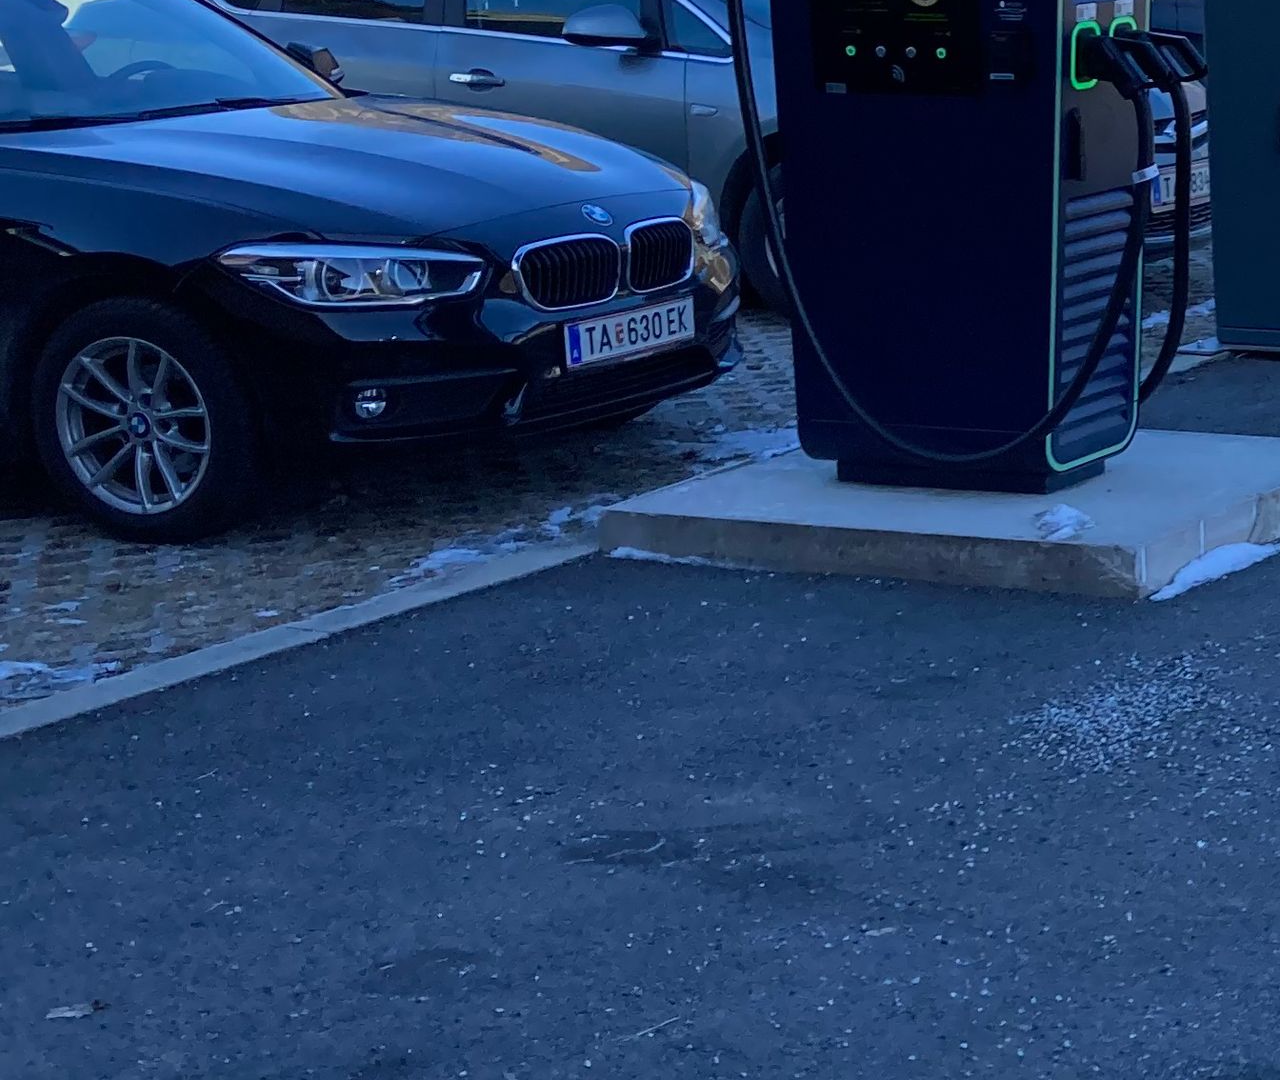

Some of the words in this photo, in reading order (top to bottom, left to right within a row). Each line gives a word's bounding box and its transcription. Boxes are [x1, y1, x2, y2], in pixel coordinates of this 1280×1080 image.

[584, 323, 613, 355] TA
[627, 311, 662, 345] 630
[666, 304, 688, 335] EK
